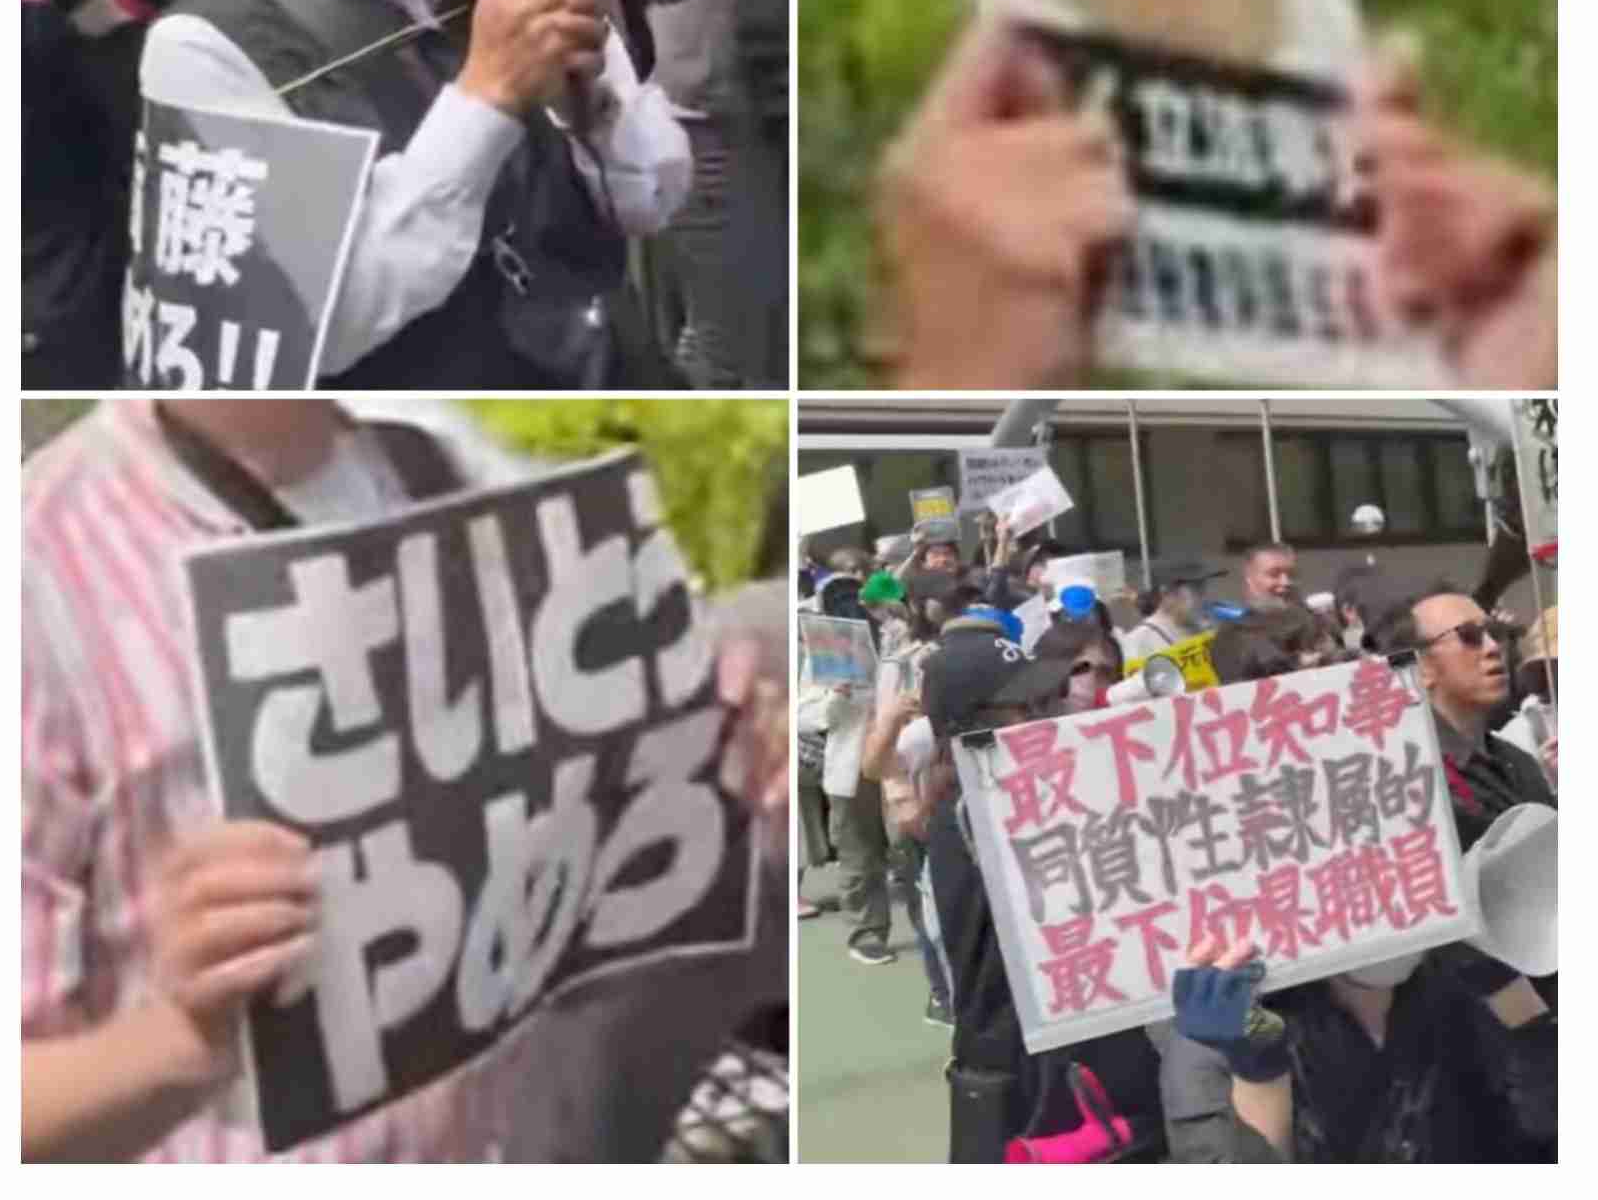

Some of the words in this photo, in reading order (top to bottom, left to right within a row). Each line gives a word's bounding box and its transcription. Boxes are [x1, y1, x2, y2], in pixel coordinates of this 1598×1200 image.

[130, 131, 268, 286] 藤
[225, 469, 711, 824] さいとう
[999, 660, 1416, 835] 最下位知事
[310, 713, 726, 1113] やめろ
